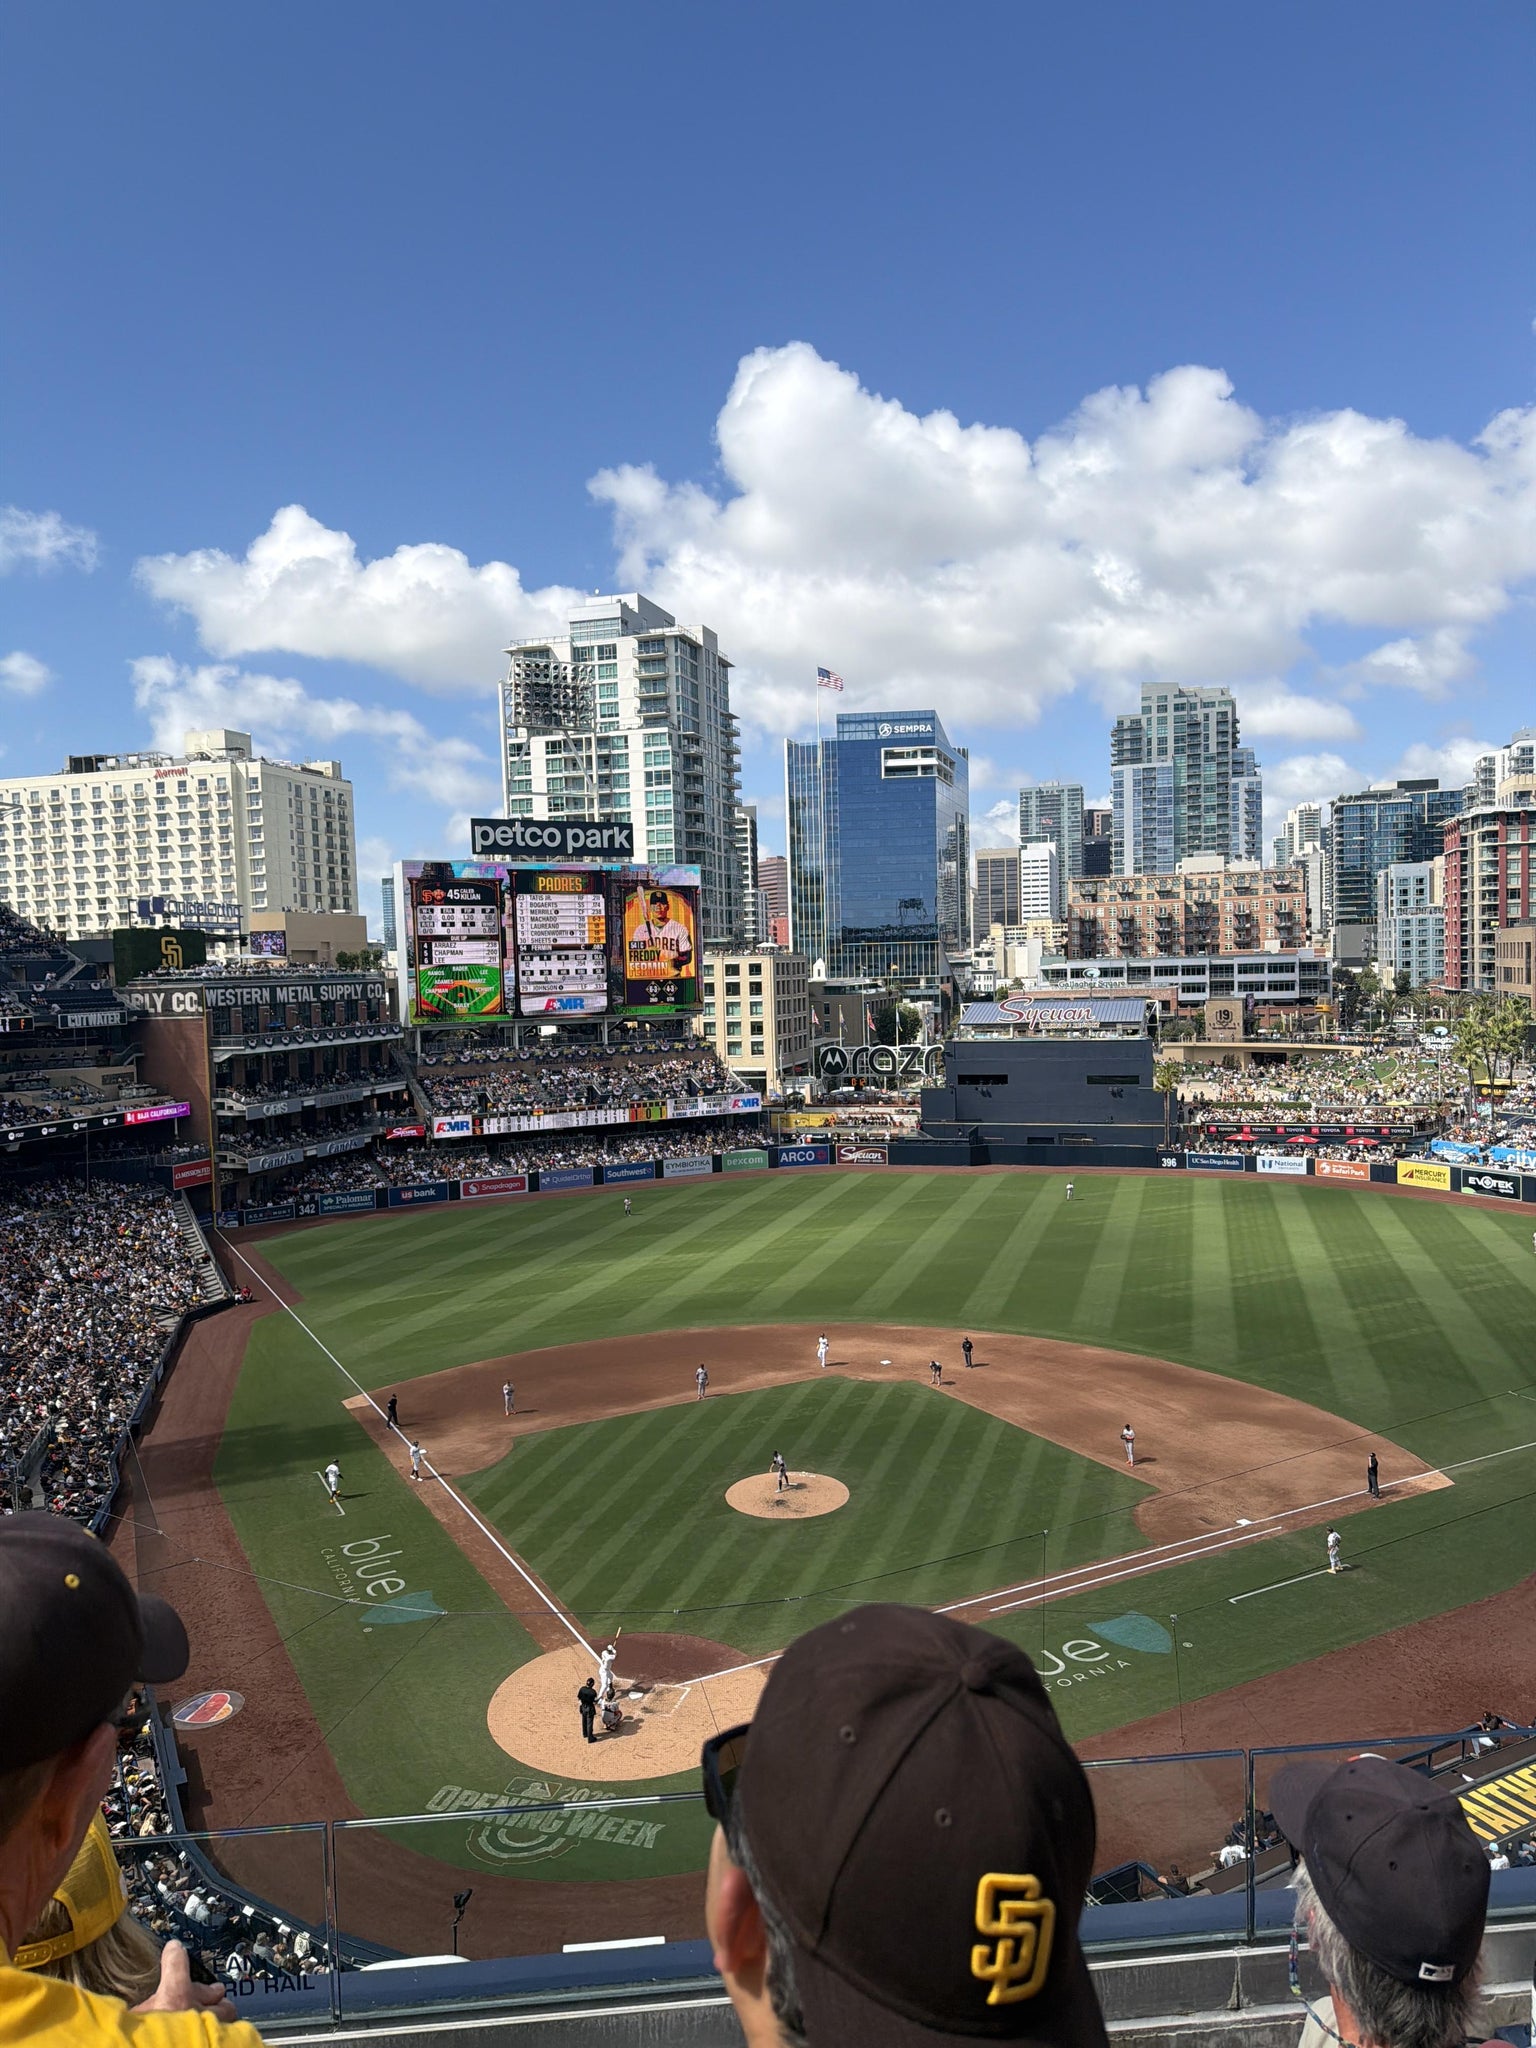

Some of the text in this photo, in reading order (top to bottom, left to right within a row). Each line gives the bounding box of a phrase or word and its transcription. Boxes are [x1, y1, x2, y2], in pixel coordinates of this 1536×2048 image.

[894, 724, 932, 733] SEMPRA
[154, 767, 189, 779] Marriott
[475, 822, 631, 854] petco park
[538, 877, 582, 891] PADRES
[447, 889, 460, 900] 45
[630, 950, 661, 962] FREDDY
[630, 962, 668, 977] FERMIN
[1058, 980, 1126, 989] Gallagher Square
[205, 983, 385, 1007] WESTERN METAL SUPPLY CO.
[172, 991, 202, 1013] CO.
[544, 997, 584, 1011] AMR
[998, 996, 1095, 1030] Sycuan
[1219, 1010, 1230, 1020] 19
[68, 1012, 120, 1028] CUTWATER
[852, 1045, 944, 1076] razr
[263, 1103, 288, 1116] ORIS
[732, 1098, 760, 1108] AMR
[138, 1112, 150, 1120] BAJA
[150, 1108, 177, 1118] CALIFORNIA
[634, 1109, 638, 1120] 1
[646, 1108, 652, 1119] 0
[436, 1120, 470, 1133] AMR
[327, 1138, 358, 1153] Canel's
[260, 1153, 295, 1170] Canel's
[780, 1151, 815, 1162] ARCO
[840, 1146, 882, 1164] Sycuan
[1162, 1158, 1177, 1168] 396
[552, 1174, 591, 1183] QuidelOrtho
[608, 1168, 646, 1178] Southwest
[1414, 1169, 1446, 1178] MERCURY
[1414, 1174, 1446, 1184] INSURANCE
[482, 1182, 520, 1191] Snapdragon
[1468, 1176, 1514, 1189] EVOTEK
[336, 1194, 372, 1204] Palomar
[414, 1188, 436, 1197] bank
[299, 1203, 316, 1215] 342
[340, 1534, 406, 1596] blue
[1035, 1640, 1110, 1676] ue
[1043, 1659, 1132, 1692] FORNIA
[425, 1784, 666, 1849] OPENING WEEK
[971, 1872, 1056, 2005] SD
[265, 1975, 315, 1994] RAIL
